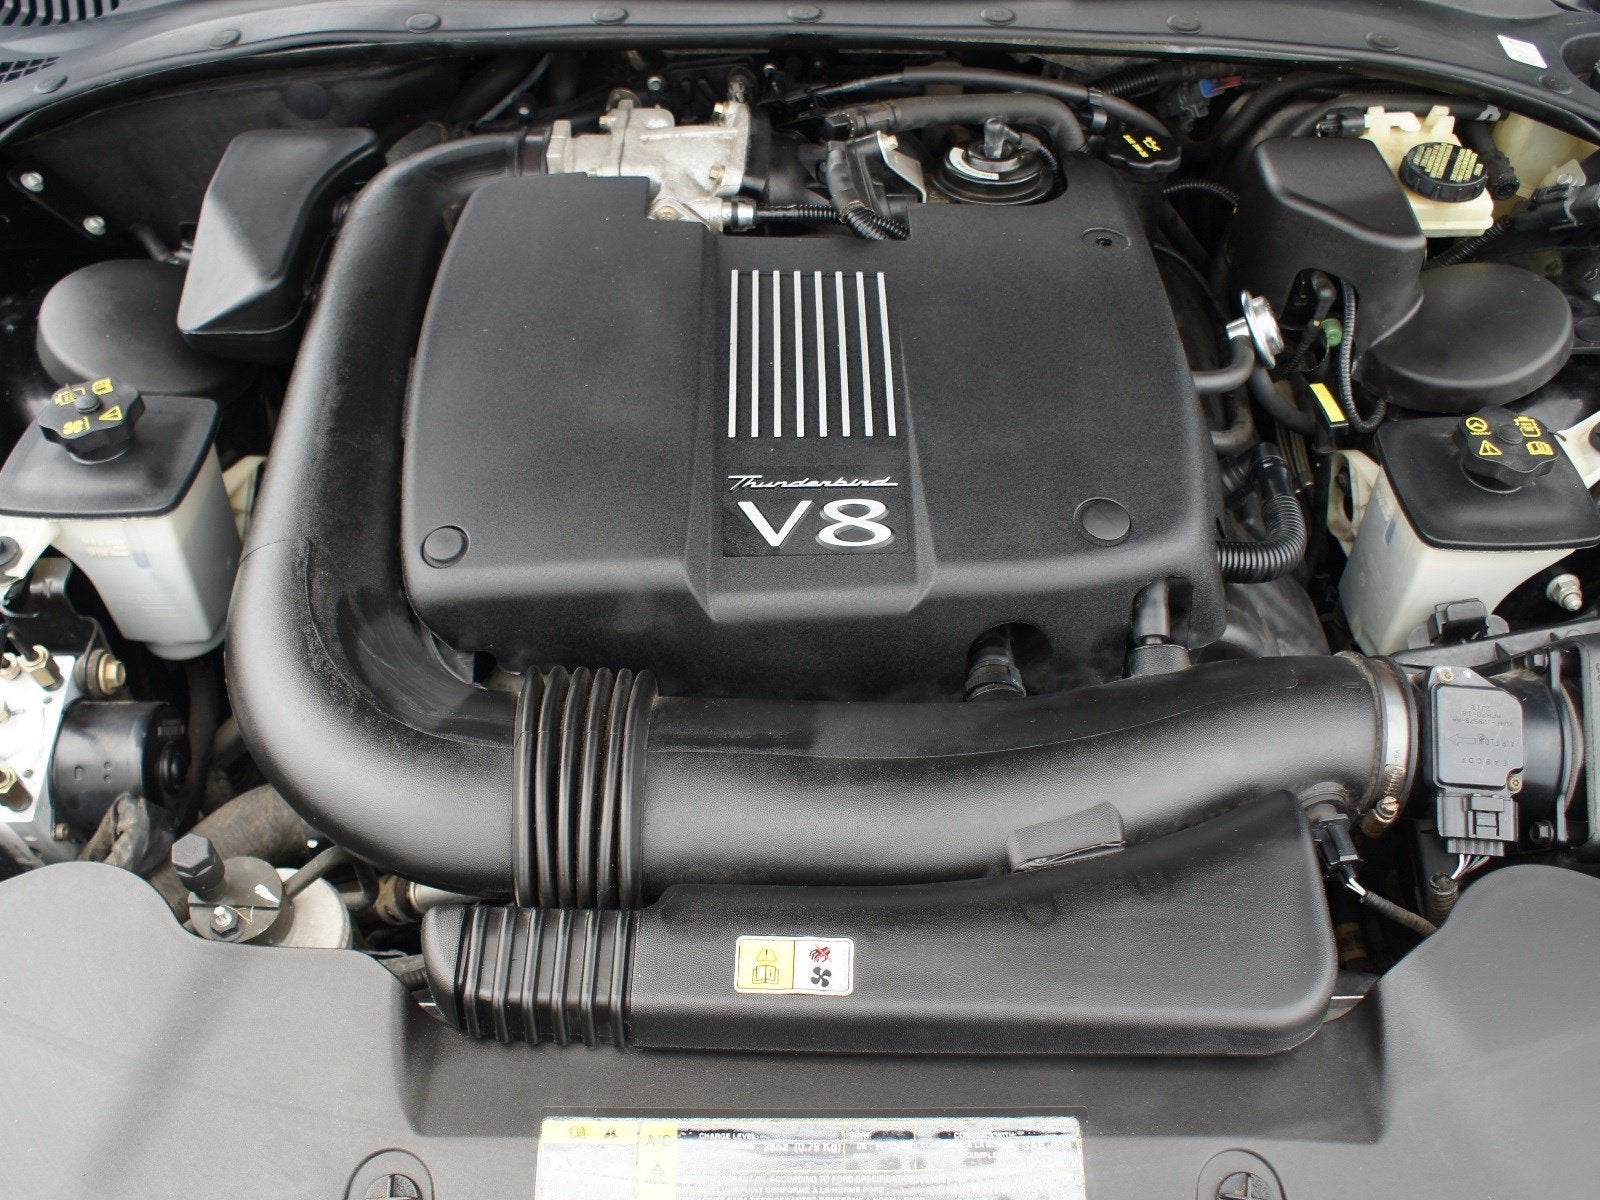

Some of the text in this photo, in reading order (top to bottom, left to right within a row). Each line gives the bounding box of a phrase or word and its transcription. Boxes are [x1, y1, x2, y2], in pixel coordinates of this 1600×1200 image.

[728, 475, 898, 491] Thunderbird
[738, 499, 895, 549] V8
[699, 1132, 731, 1140] CHARGE
[823, 1142, 841, 1154] Kg)
[769, 1175, 817, 1183] ACCORDING
[819, 1175, 830, 1183] TO
[832, 1175, 854, 1183] FORD
[765, 1186, 810, 1194] CONFORME
[832, 1186, 861, 1194] NORME
[863, 1186, 885, 1194] FORD
